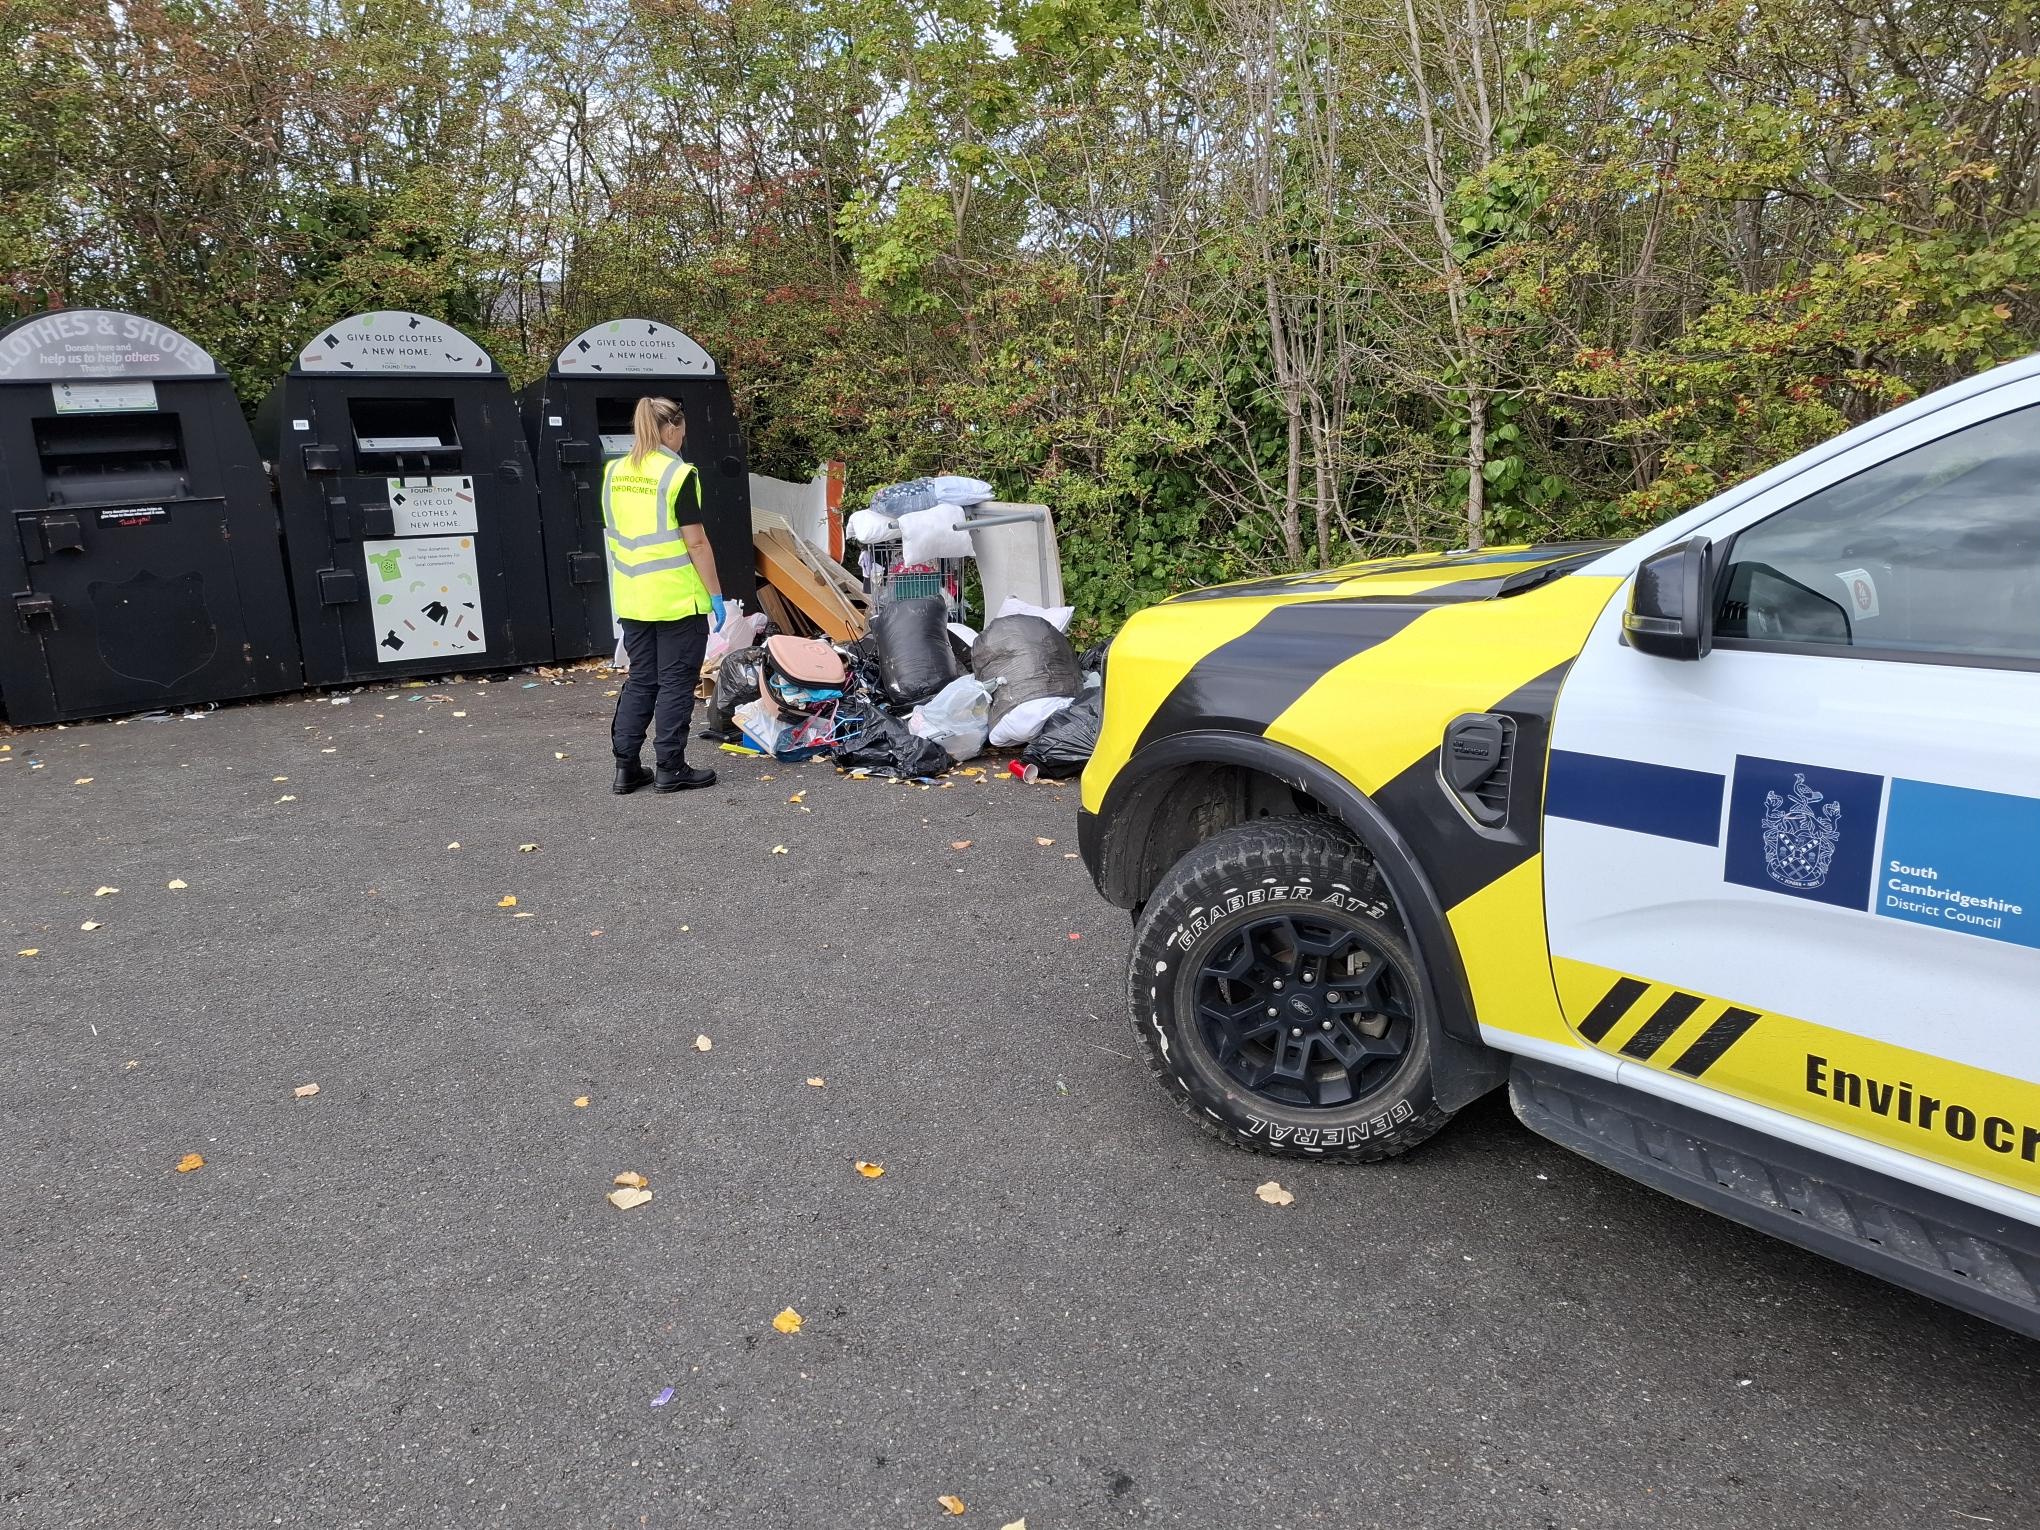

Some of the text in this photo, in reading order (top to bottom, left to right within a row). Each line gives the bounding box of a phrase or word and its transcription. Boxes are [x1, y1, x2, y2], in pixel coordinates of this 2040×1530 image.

[96, 315, 118, 336] &
[123, 317, 209, 371] SHOES
[347, 333, 443, 343] GIVE OLD CLOTHES
[596, 339, 617, 347] GIVE
[639, 340, 676, 348] CLOTHES
[115, 343, 132, 351] and
[362, 347, 432, 356] A NEW HOME.
[39, 351, 160, 365] help us to help others
[413, 499, 433, 507] GIVE
[411, 510, 449, 518] CLOTHES
[410, 521, 430, 529] NEW
[1889, 860, 1938, 880] South
[1888, 878, 2023, 915] Cambridgeshire
[1177, 885, 1313, 951] GRABBER
[1886, 895, 2002, 929] District Council
[1246, 1099, 1415, 1146] GENERAL
